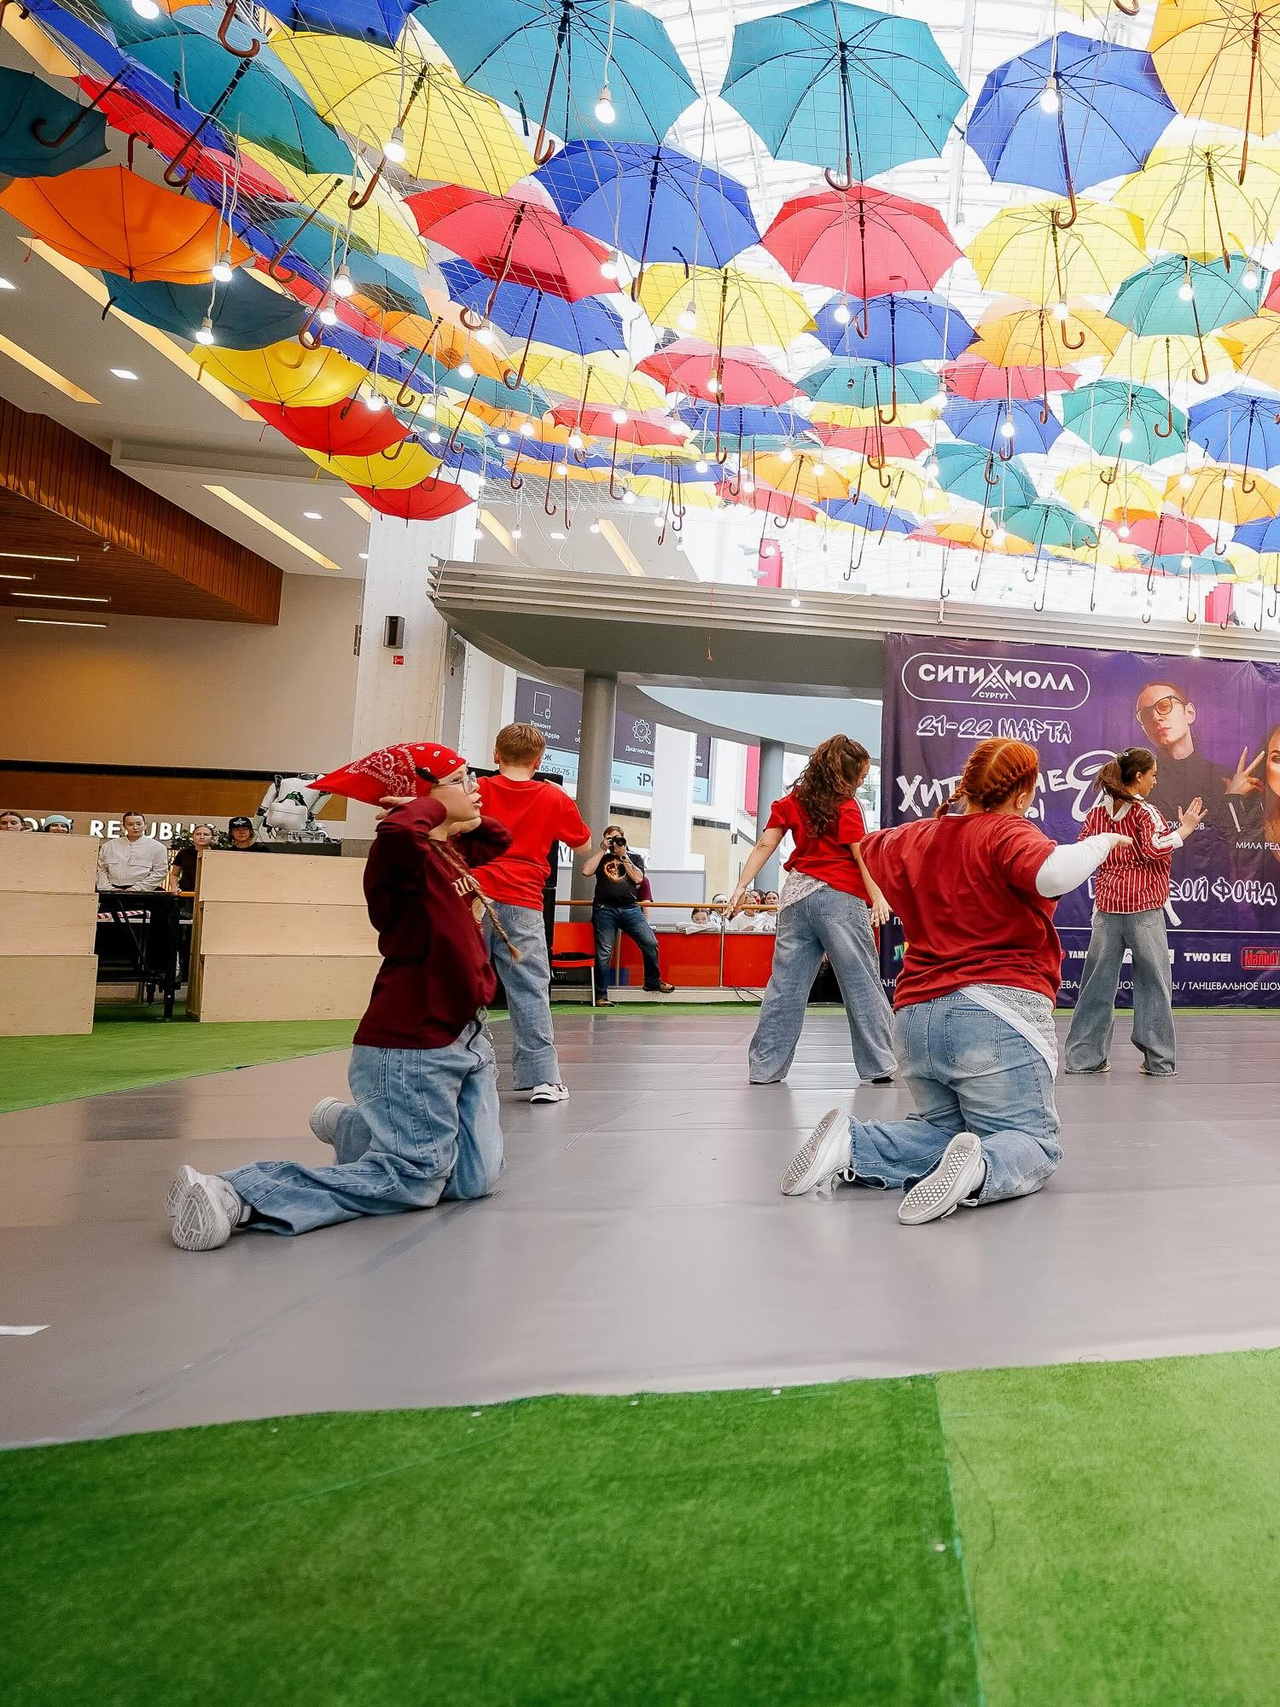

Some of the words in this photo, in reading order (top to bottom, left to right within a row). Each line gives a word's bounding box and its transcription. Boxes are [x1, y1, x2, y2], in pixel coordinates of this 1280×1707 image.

[918, 663, 985, 685] СИТИ
[1004, 669, 1075, 692] МОЛЛ
[979, 691, 1010, 700] СУРГУТ
[916, 714, 994, 739] 21-22
[998, 717, 1073, 745] МАРТА
[1235, 841, 1263, 850] МИЛА
[1211, 876, 1278, 906] ФОНД
[1184, 952, 1211, 963] TWO
[1213, 953, 1232, 963] KEI
[1188, 981, 1259, 991] ТАНЦЕВАЛЬНОЕ
